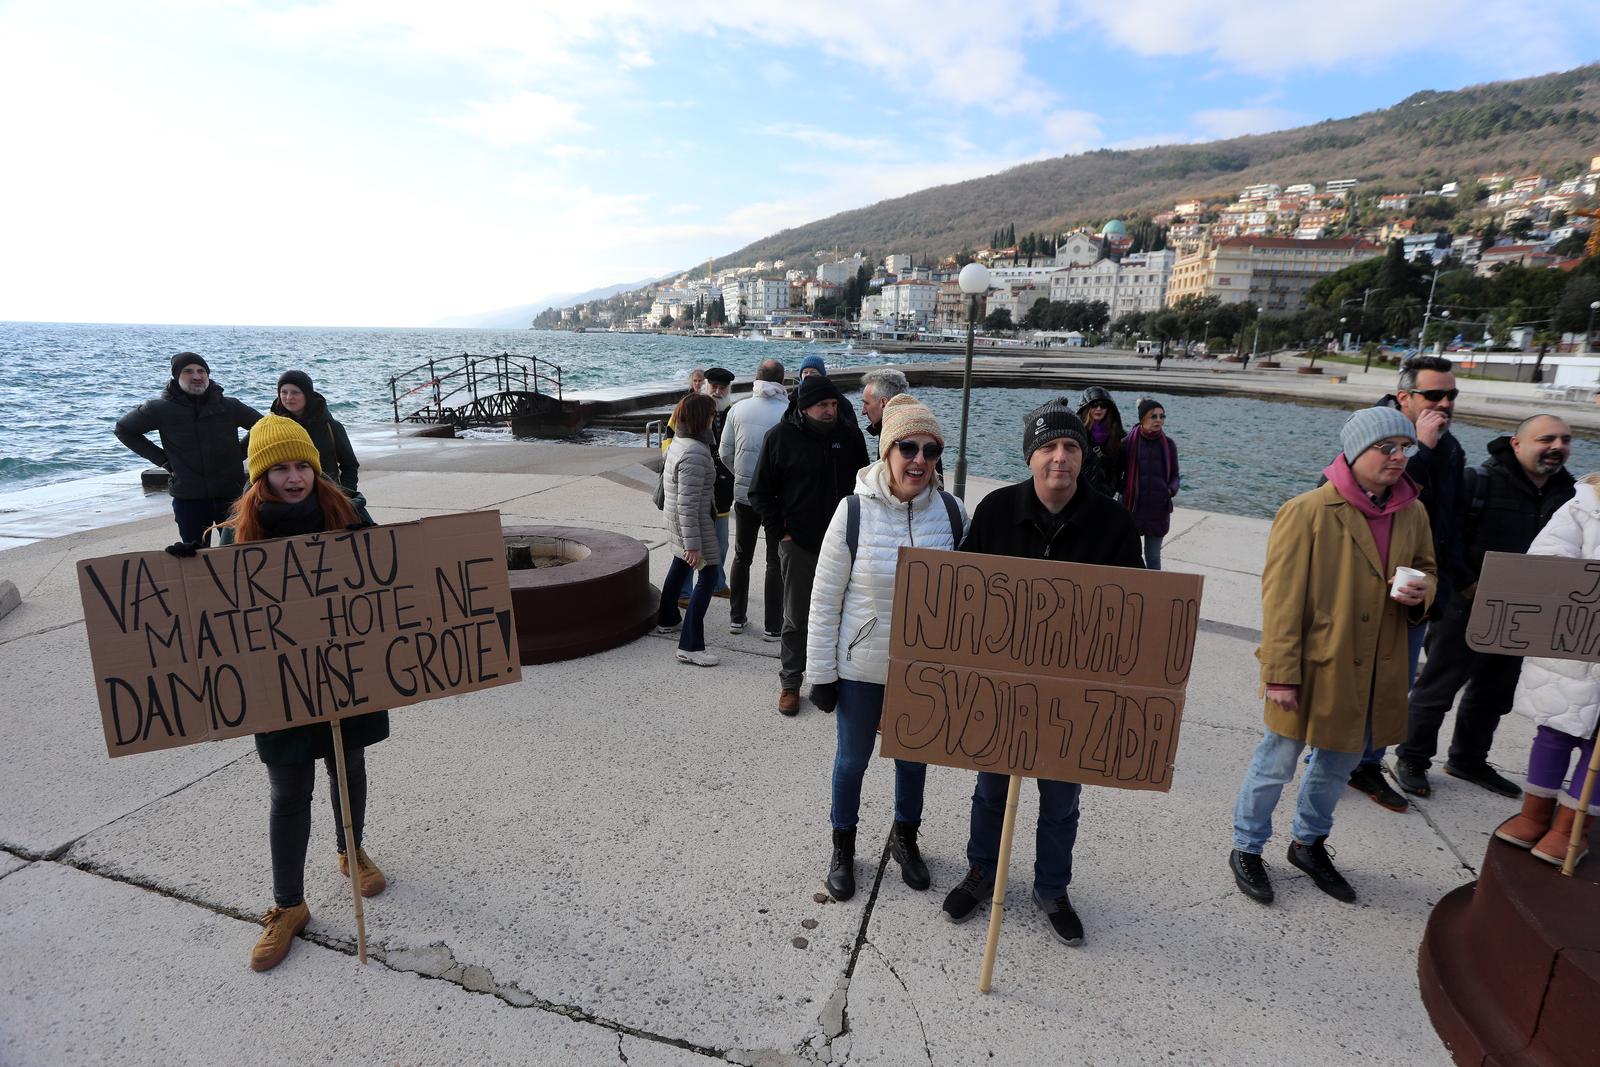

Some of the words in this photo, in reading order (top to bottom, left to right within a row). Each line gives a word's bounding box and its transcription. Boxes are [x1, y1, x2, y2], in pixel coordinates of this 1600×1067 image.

[84, 557, 172, 634] VA
[203, 529, 398, 608] VRAŽJU
[145, 605, 298, 668] MATER
[320, 584, 433, 637] HOTE,
[436, 557, 505, 623] NE
[904, 561, 1143, 676] NASIPAVAJ
[1165, 599, 1197, 685] U
[1471, 600, 1541, 649] JE
[105, 663, 246, 746] DAMO
[278, 638, 369, 721] NAŠE
[385, 610, 513, 697] GROTE!
[896, 660, 1038, 771] SVOJA
[1079, 689, 1175, 783] ZIDA
